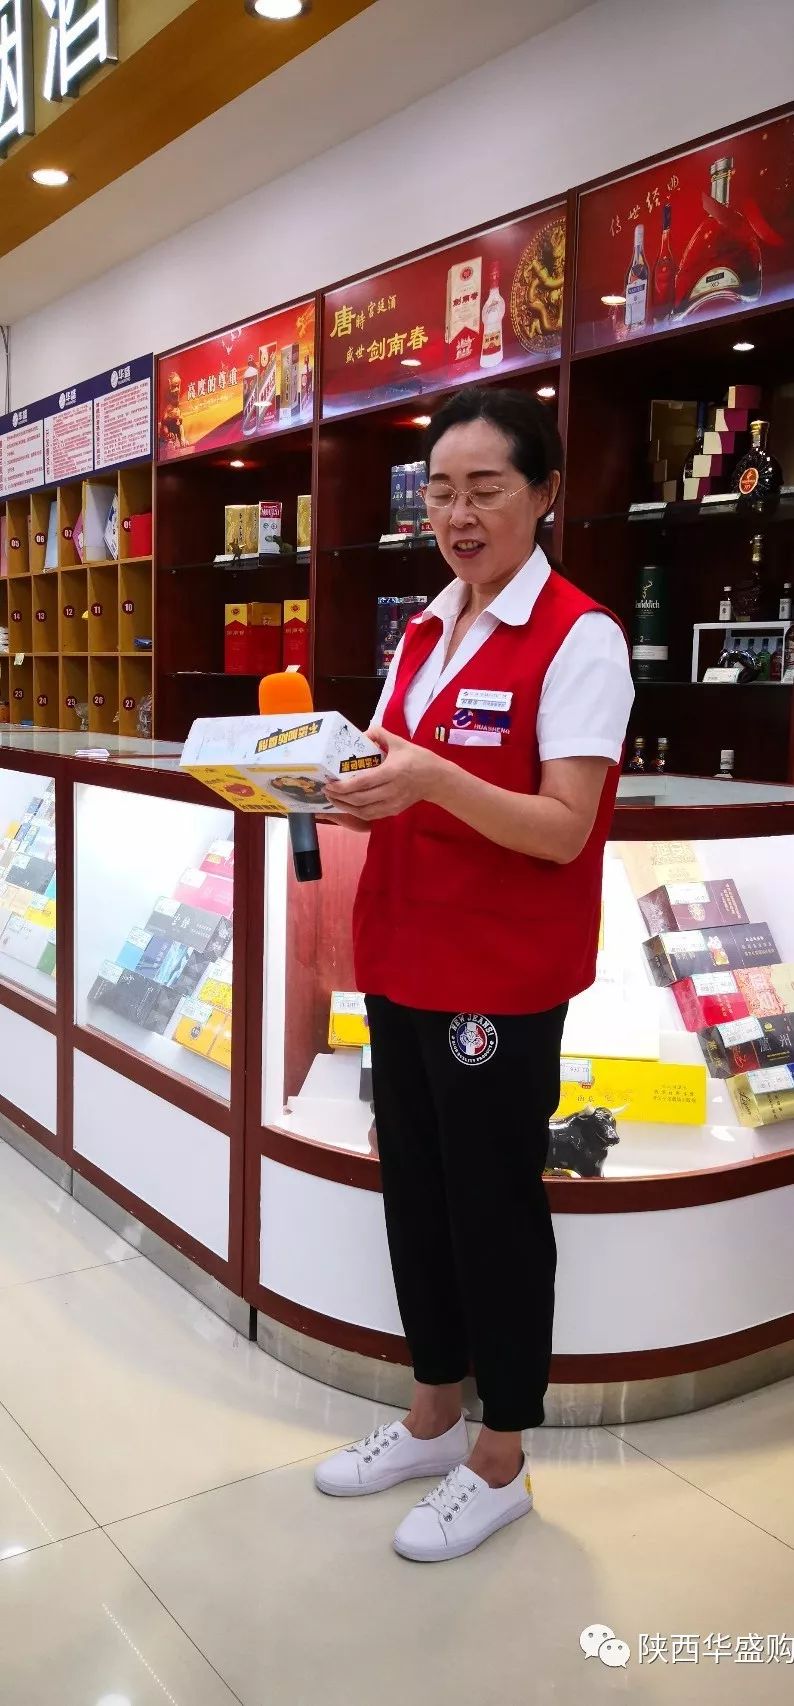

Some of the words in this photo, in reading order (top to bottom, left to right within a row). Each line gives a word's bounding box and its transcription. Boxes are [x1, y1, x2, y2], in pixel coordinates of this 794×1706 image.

[64, 529, 73, 538] 07
[36, 535, 45, 543] 06
[11, 539, 20, 548] 05
[94, 606, 101, 614] 11
[124, 603, 133, 612] 10
[13, 612, 20, 620] 14
[38, 612, 45, 620] 13
[65, 608, 73, 616] 12
[14, 690, 23, 698] 23
[94, 696, 104, 704] 26
[125, 699, 133, 708] 27
